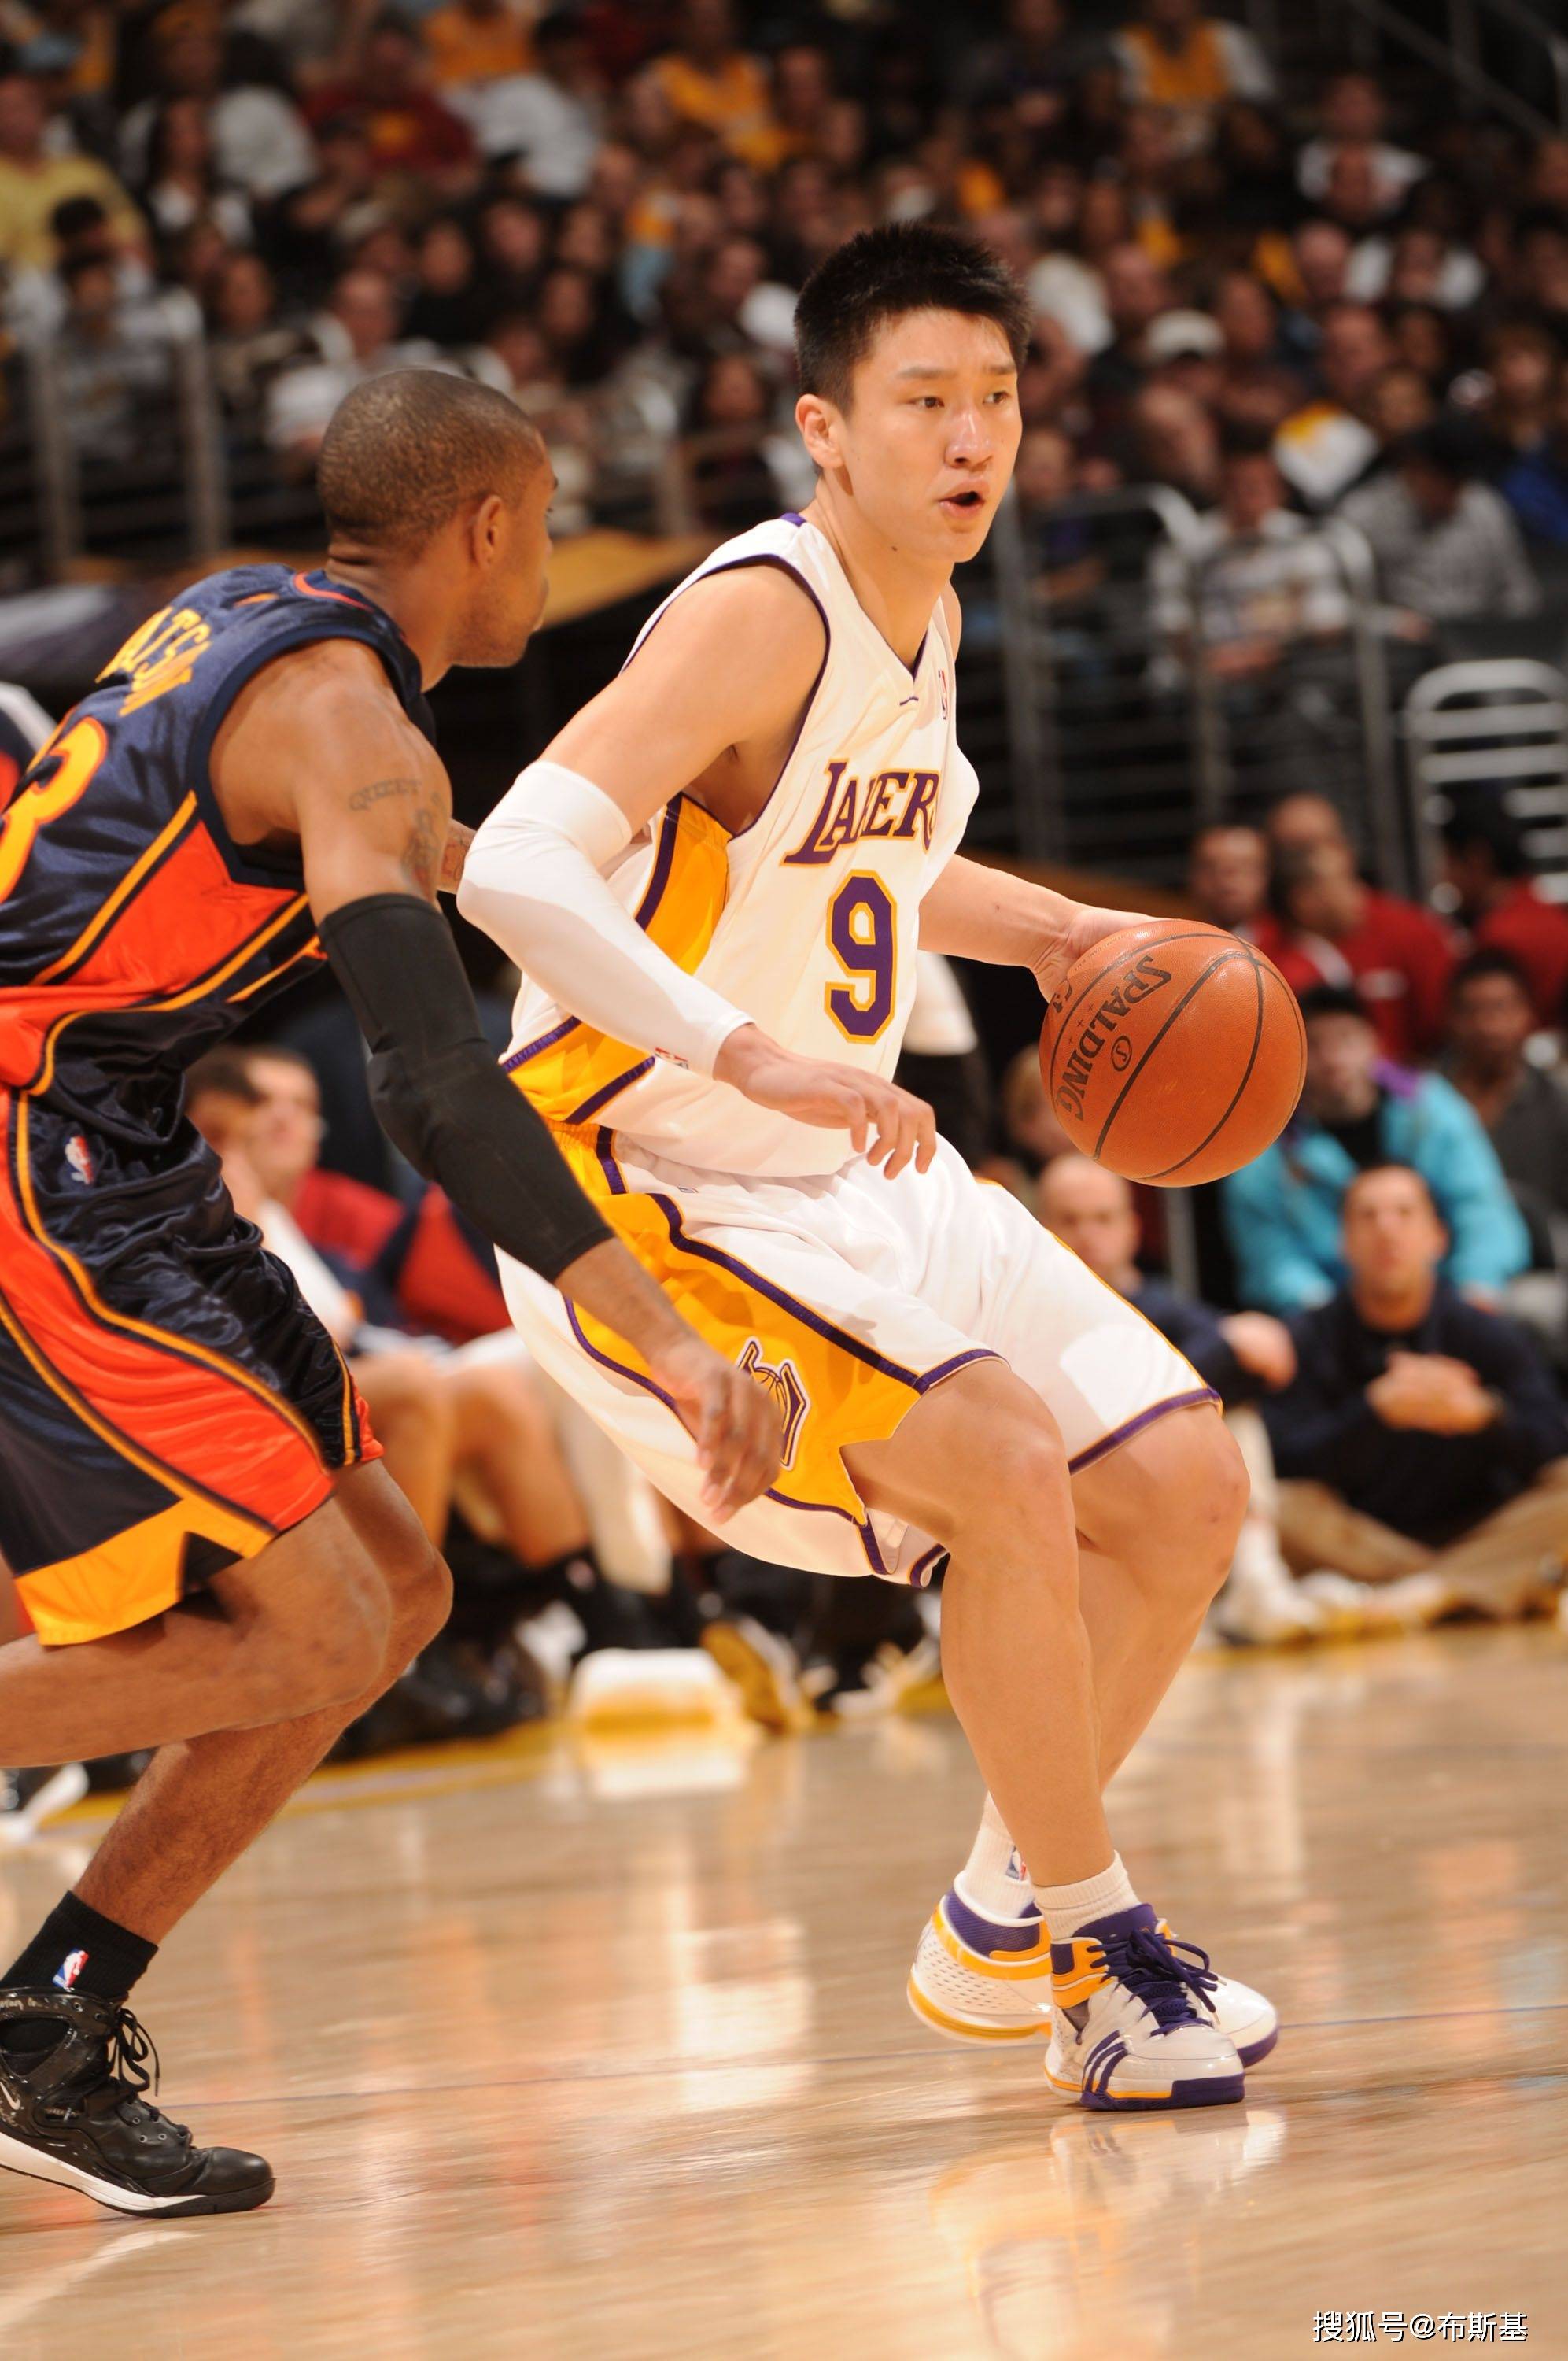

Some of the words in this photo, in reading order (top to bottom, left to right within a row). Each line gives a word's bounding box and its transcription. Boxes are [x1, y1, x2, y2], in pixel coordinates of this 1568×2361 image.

[779, 758, 940, 866] LAER
[824, 870, 897, 1045] 9
[1055, 955, 1172, 1121] SPALDING
